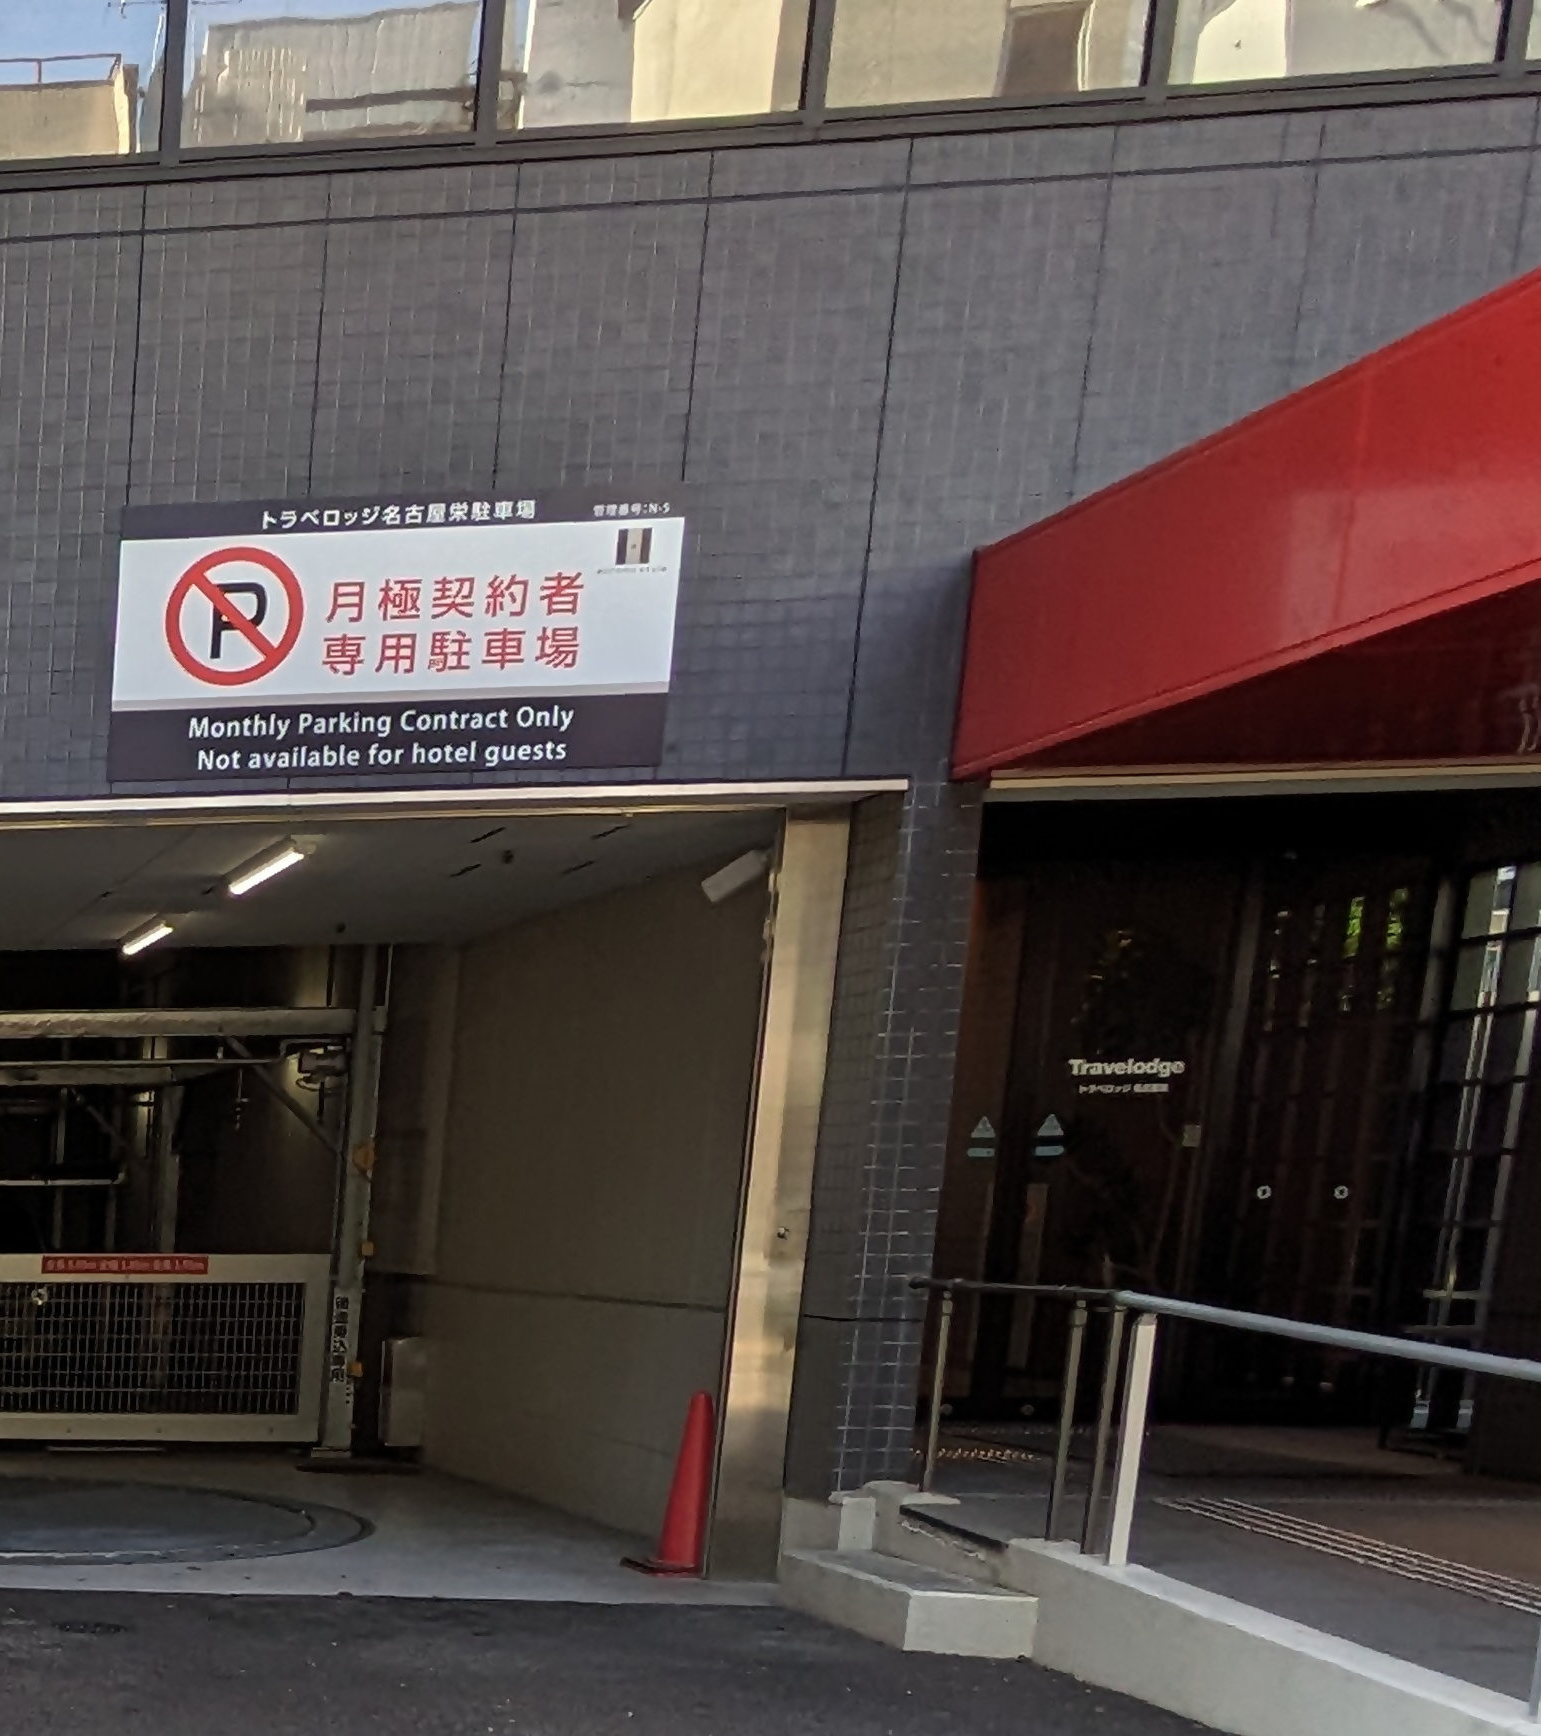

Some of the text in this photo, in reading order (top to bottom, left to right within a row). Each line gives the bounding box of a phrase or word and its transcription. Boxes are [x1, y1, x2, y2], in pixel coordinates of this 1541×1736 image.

[261, 499, 536, 530] トラベロッジ名古屋栄駐車場
[326, 571, 584, 623] 月極契約者
[322, 625, 580, 676] 専用駐車場
[188, 704, 574, 741] Monthly Parking Contract Only
[197, 740, 567, 771] Not available for hotel guests
[1068, 1057, 1186, 1078] Travelodge
